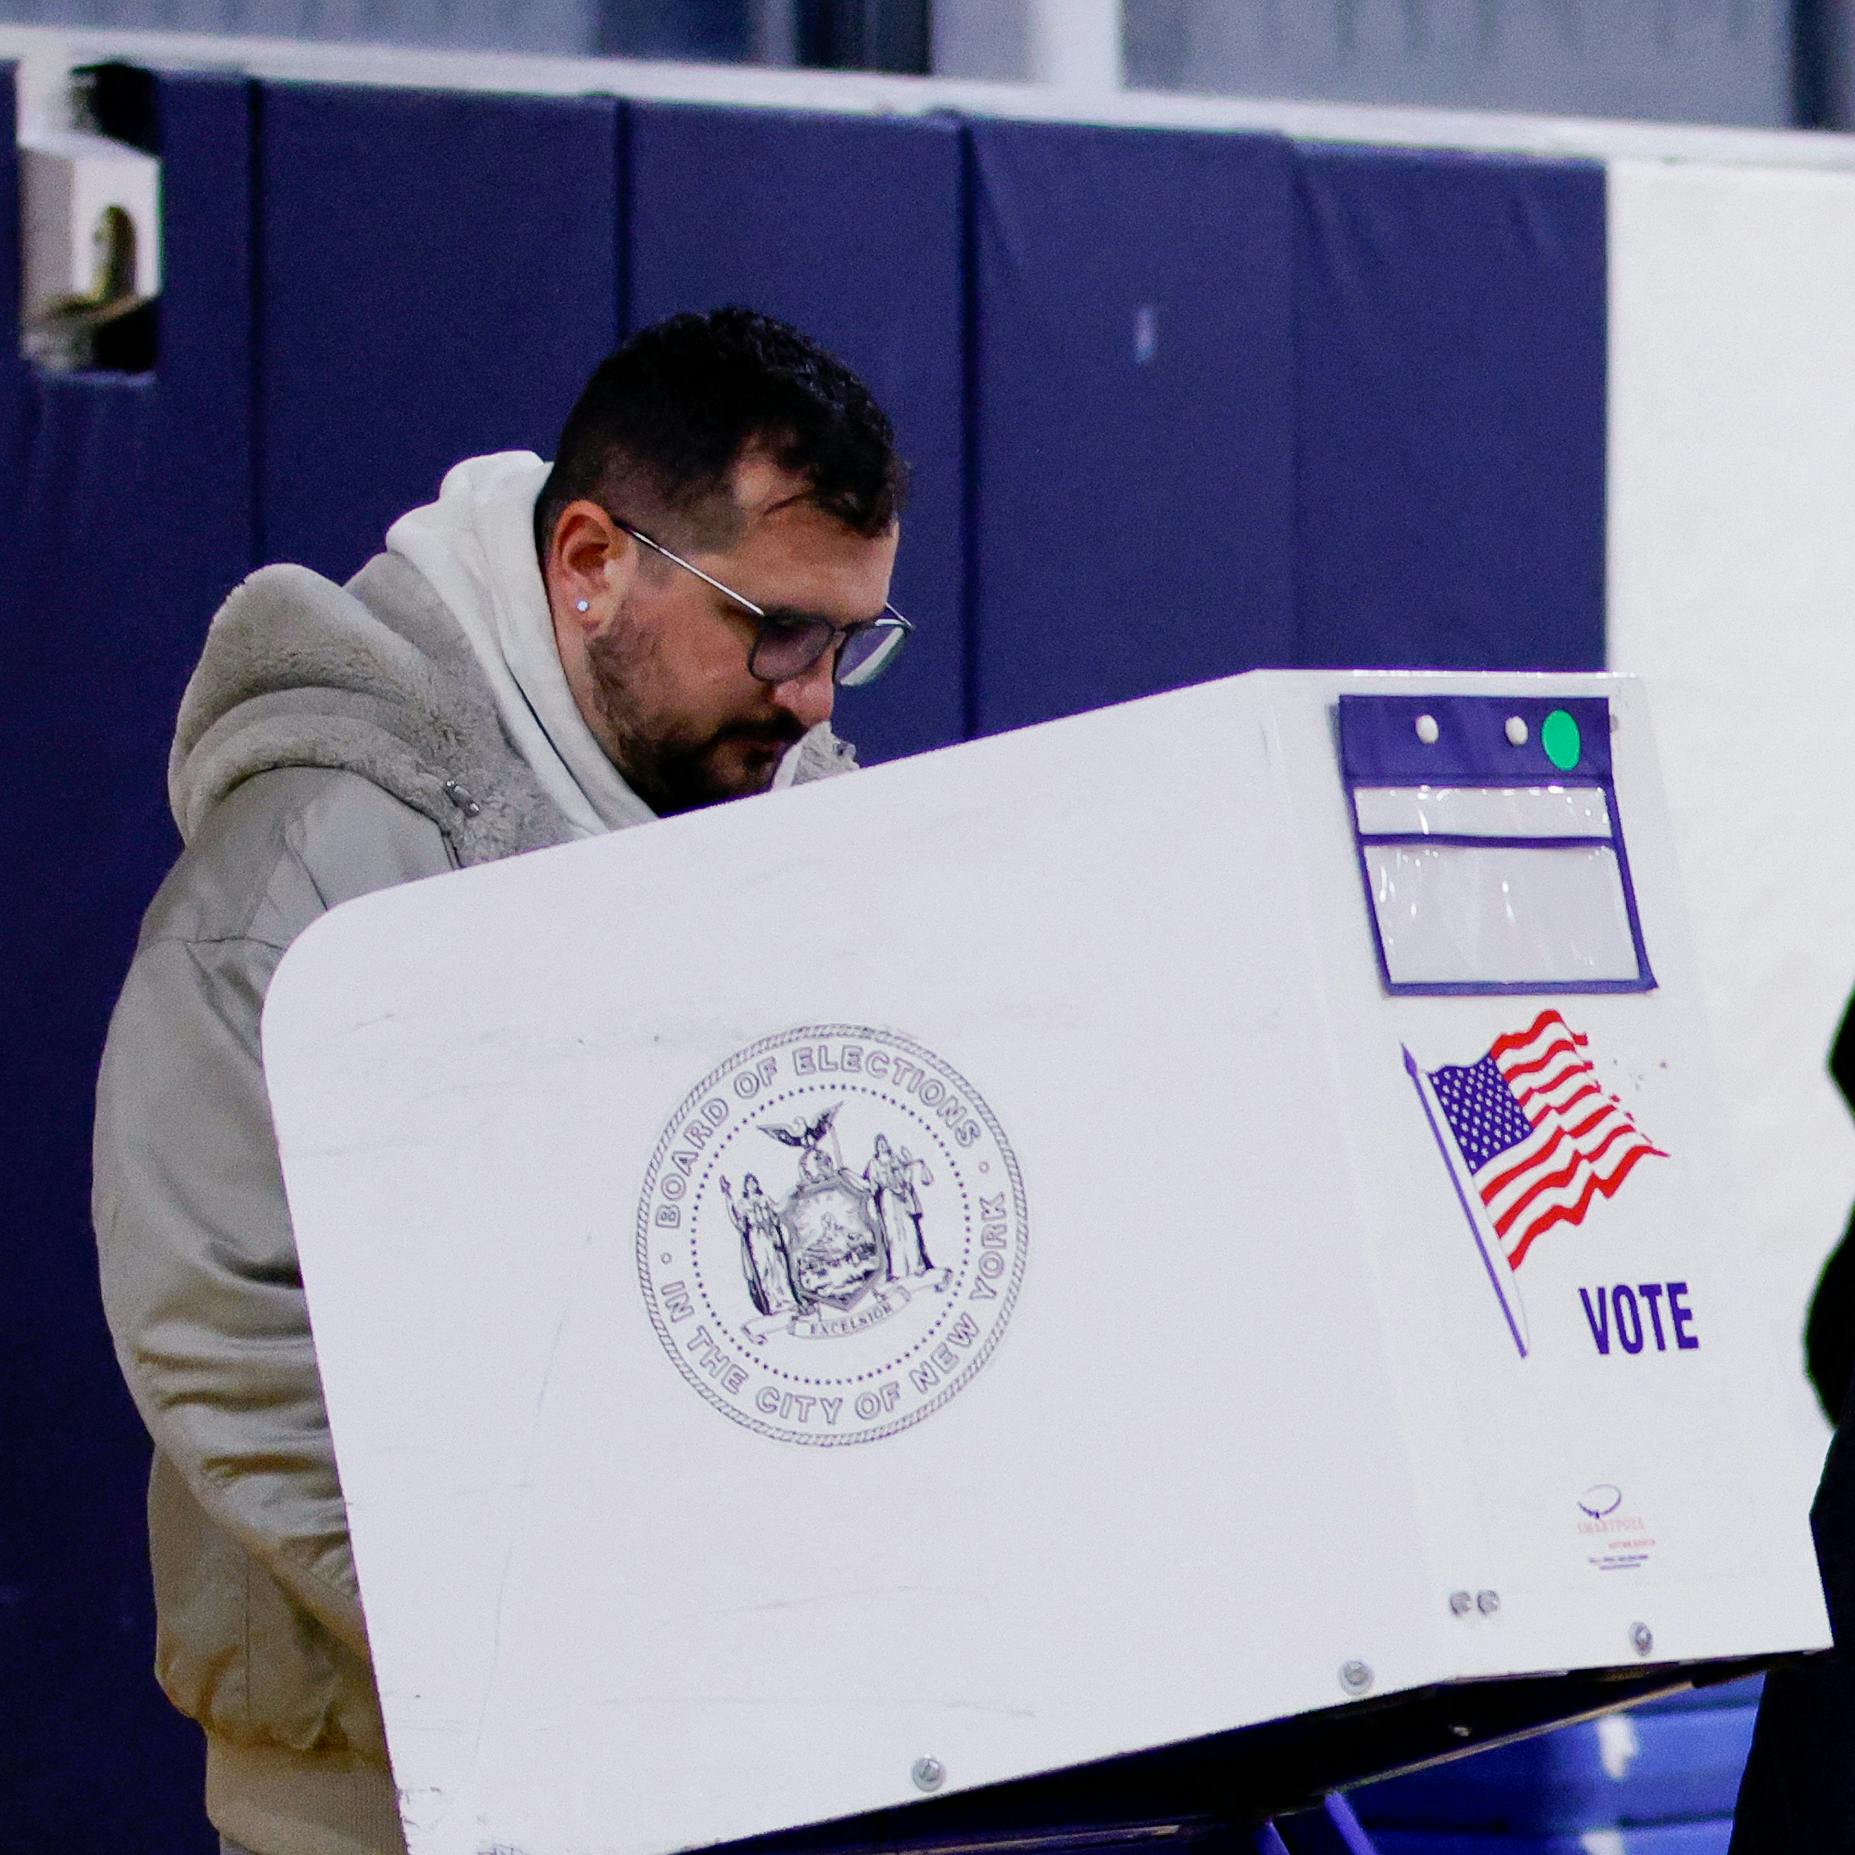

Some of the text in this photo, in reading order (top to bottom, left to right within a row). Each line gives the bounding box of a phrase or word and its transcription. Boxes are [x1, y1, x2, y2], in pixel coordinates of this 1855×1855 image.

[655, 1044, 980, 1229] BOARD OF ELECTIONS
[661, 1193, 1008, 1425] IN THE CITY OF NEW YORK
[810, 1304, 893, 1335] EXCELSIOR
[1579, 1282, 1699, 1355] VOTE
